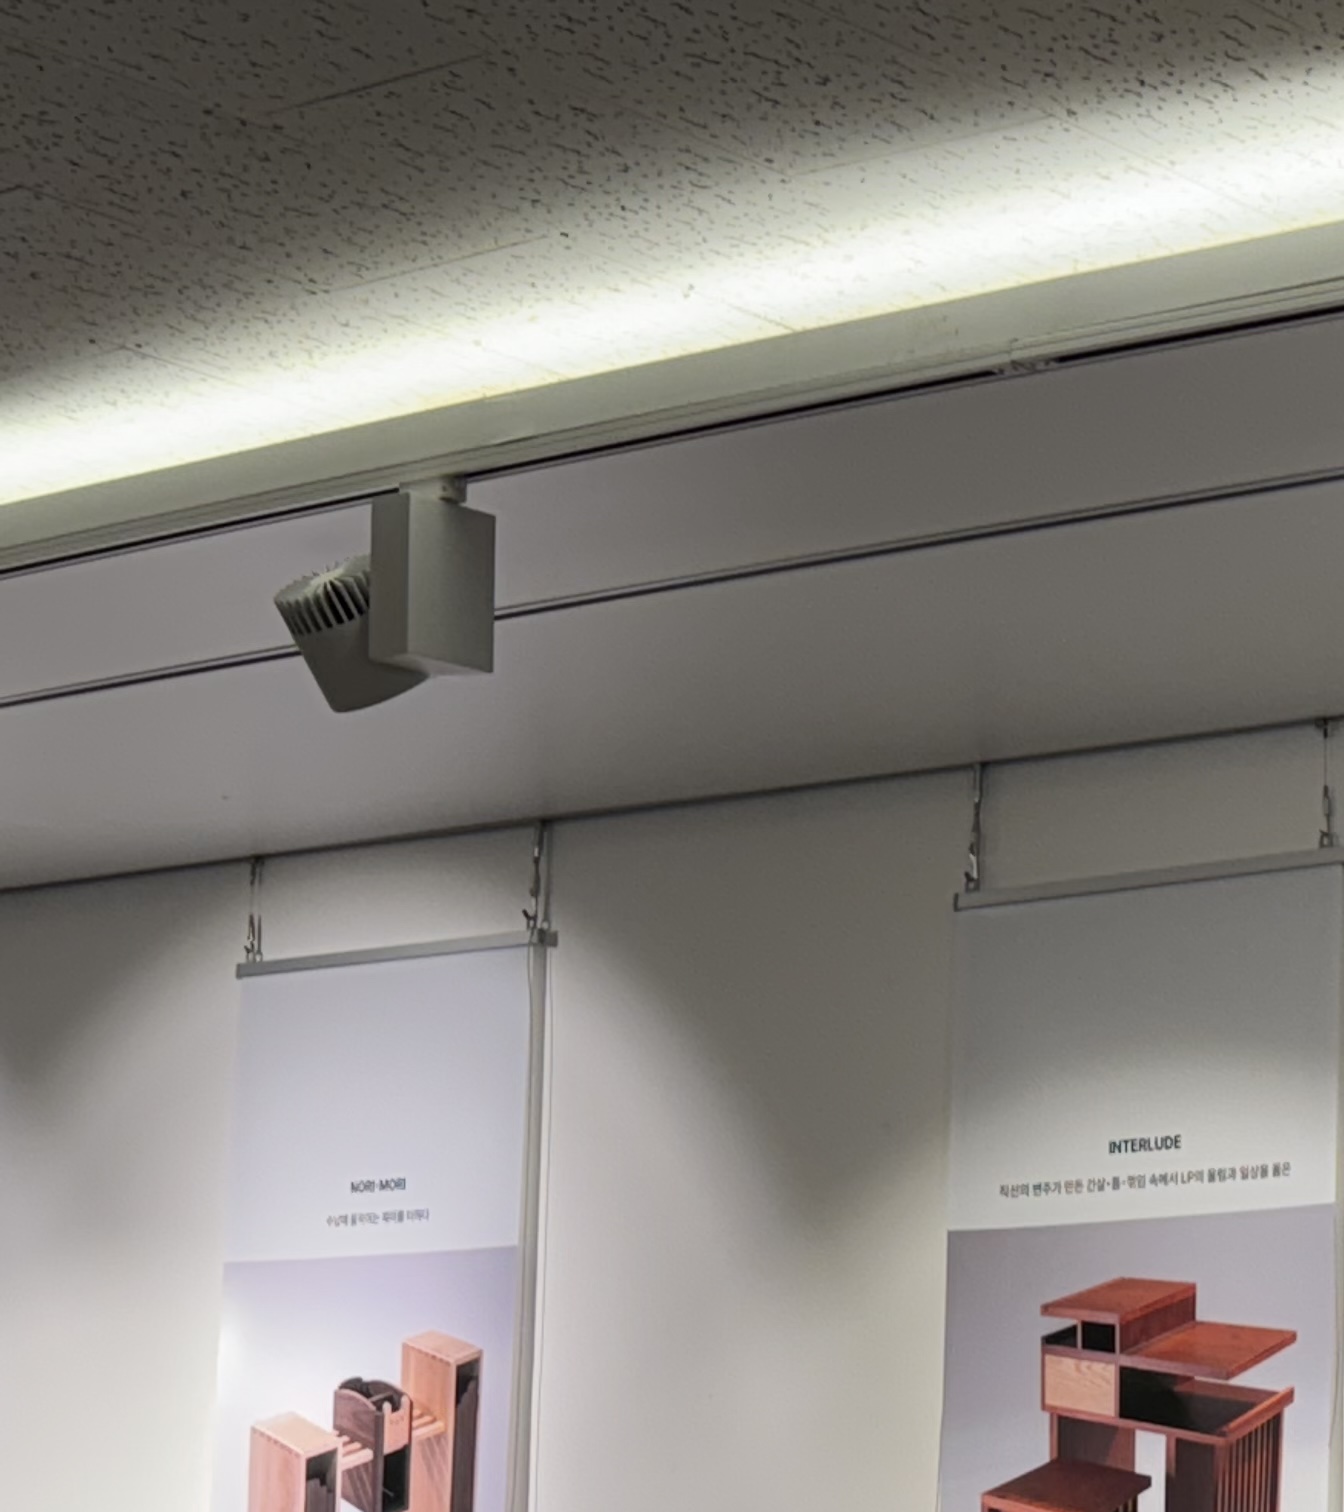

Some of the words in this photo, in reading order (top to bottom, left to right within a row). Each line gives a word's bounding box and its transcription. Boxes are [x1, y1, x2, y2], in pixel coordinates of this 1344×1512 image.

[1109, 1135, 1181, 1154] INTERLUDE
[1149, 1172, 1178, 1187] 속에서
[1181, 1170, 1204, 1184] LP의
